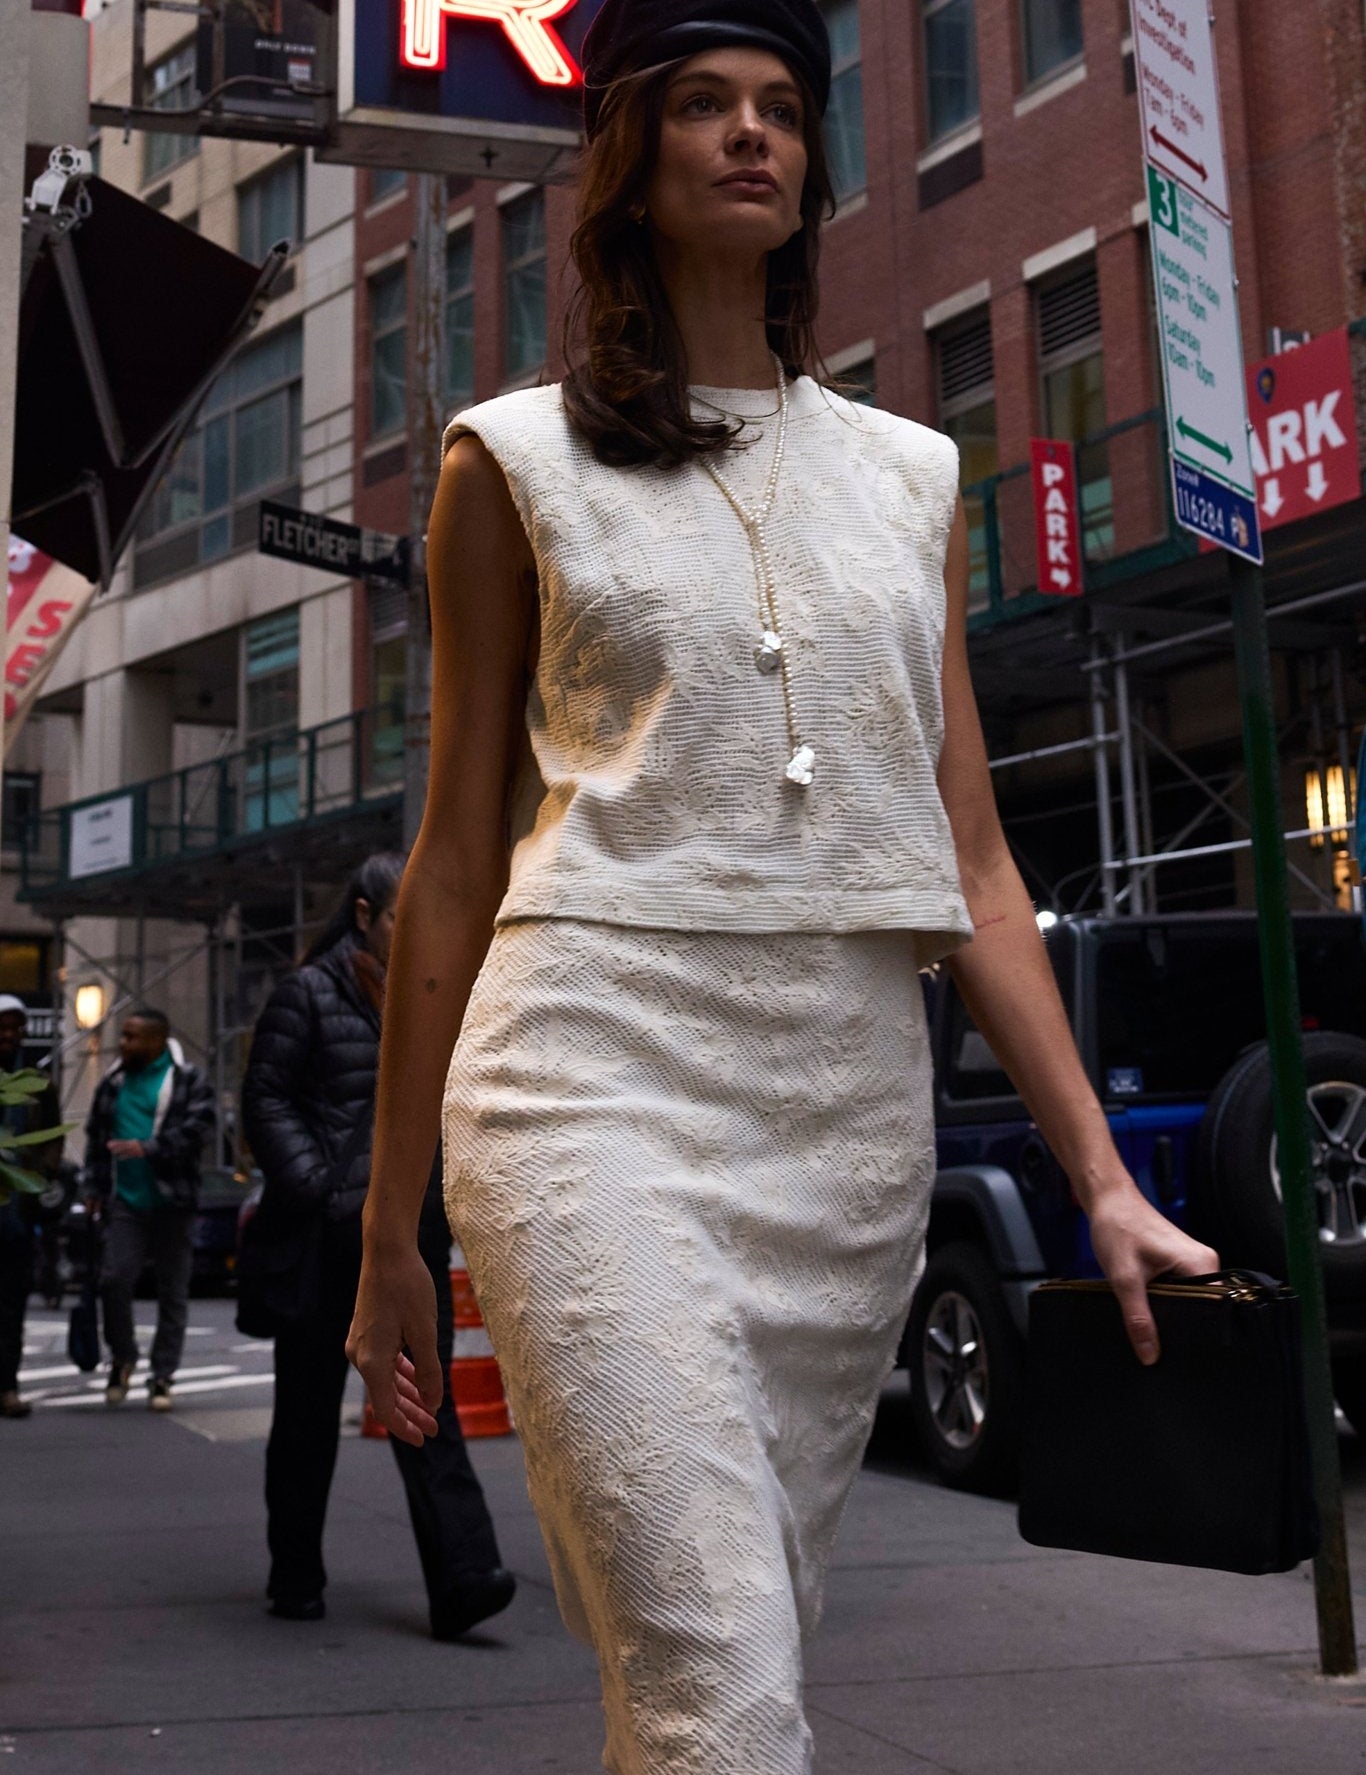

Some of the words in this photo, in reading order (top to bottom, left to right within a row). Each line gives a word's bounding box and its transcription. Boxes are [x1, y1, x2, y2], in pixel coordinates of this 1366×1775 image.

[1138, 12, 1196, 76] Investigation
[1141, 62, 1174, 105] Monday
[1180, 92, 1204, 131] Friday
[1155, 172, 1173, 227] 3
[1160, 251, 1190, 289] Monday
[1197, 275, 1221, 311] Friday
[1162, 276, 1180, 302] 6pm
[1187, 292, 1207, 321] 10pm
[1165, 314, 1201, 358] Saturday
[1195, 359, 1216, 388] 10pm
[1250, 388, 1346, 478] ARK
[1042, 462, 1071, 565] PARK
[1178, 486, 1225, 537] 116284
[262, 513, 349, 566] FLETCHER
